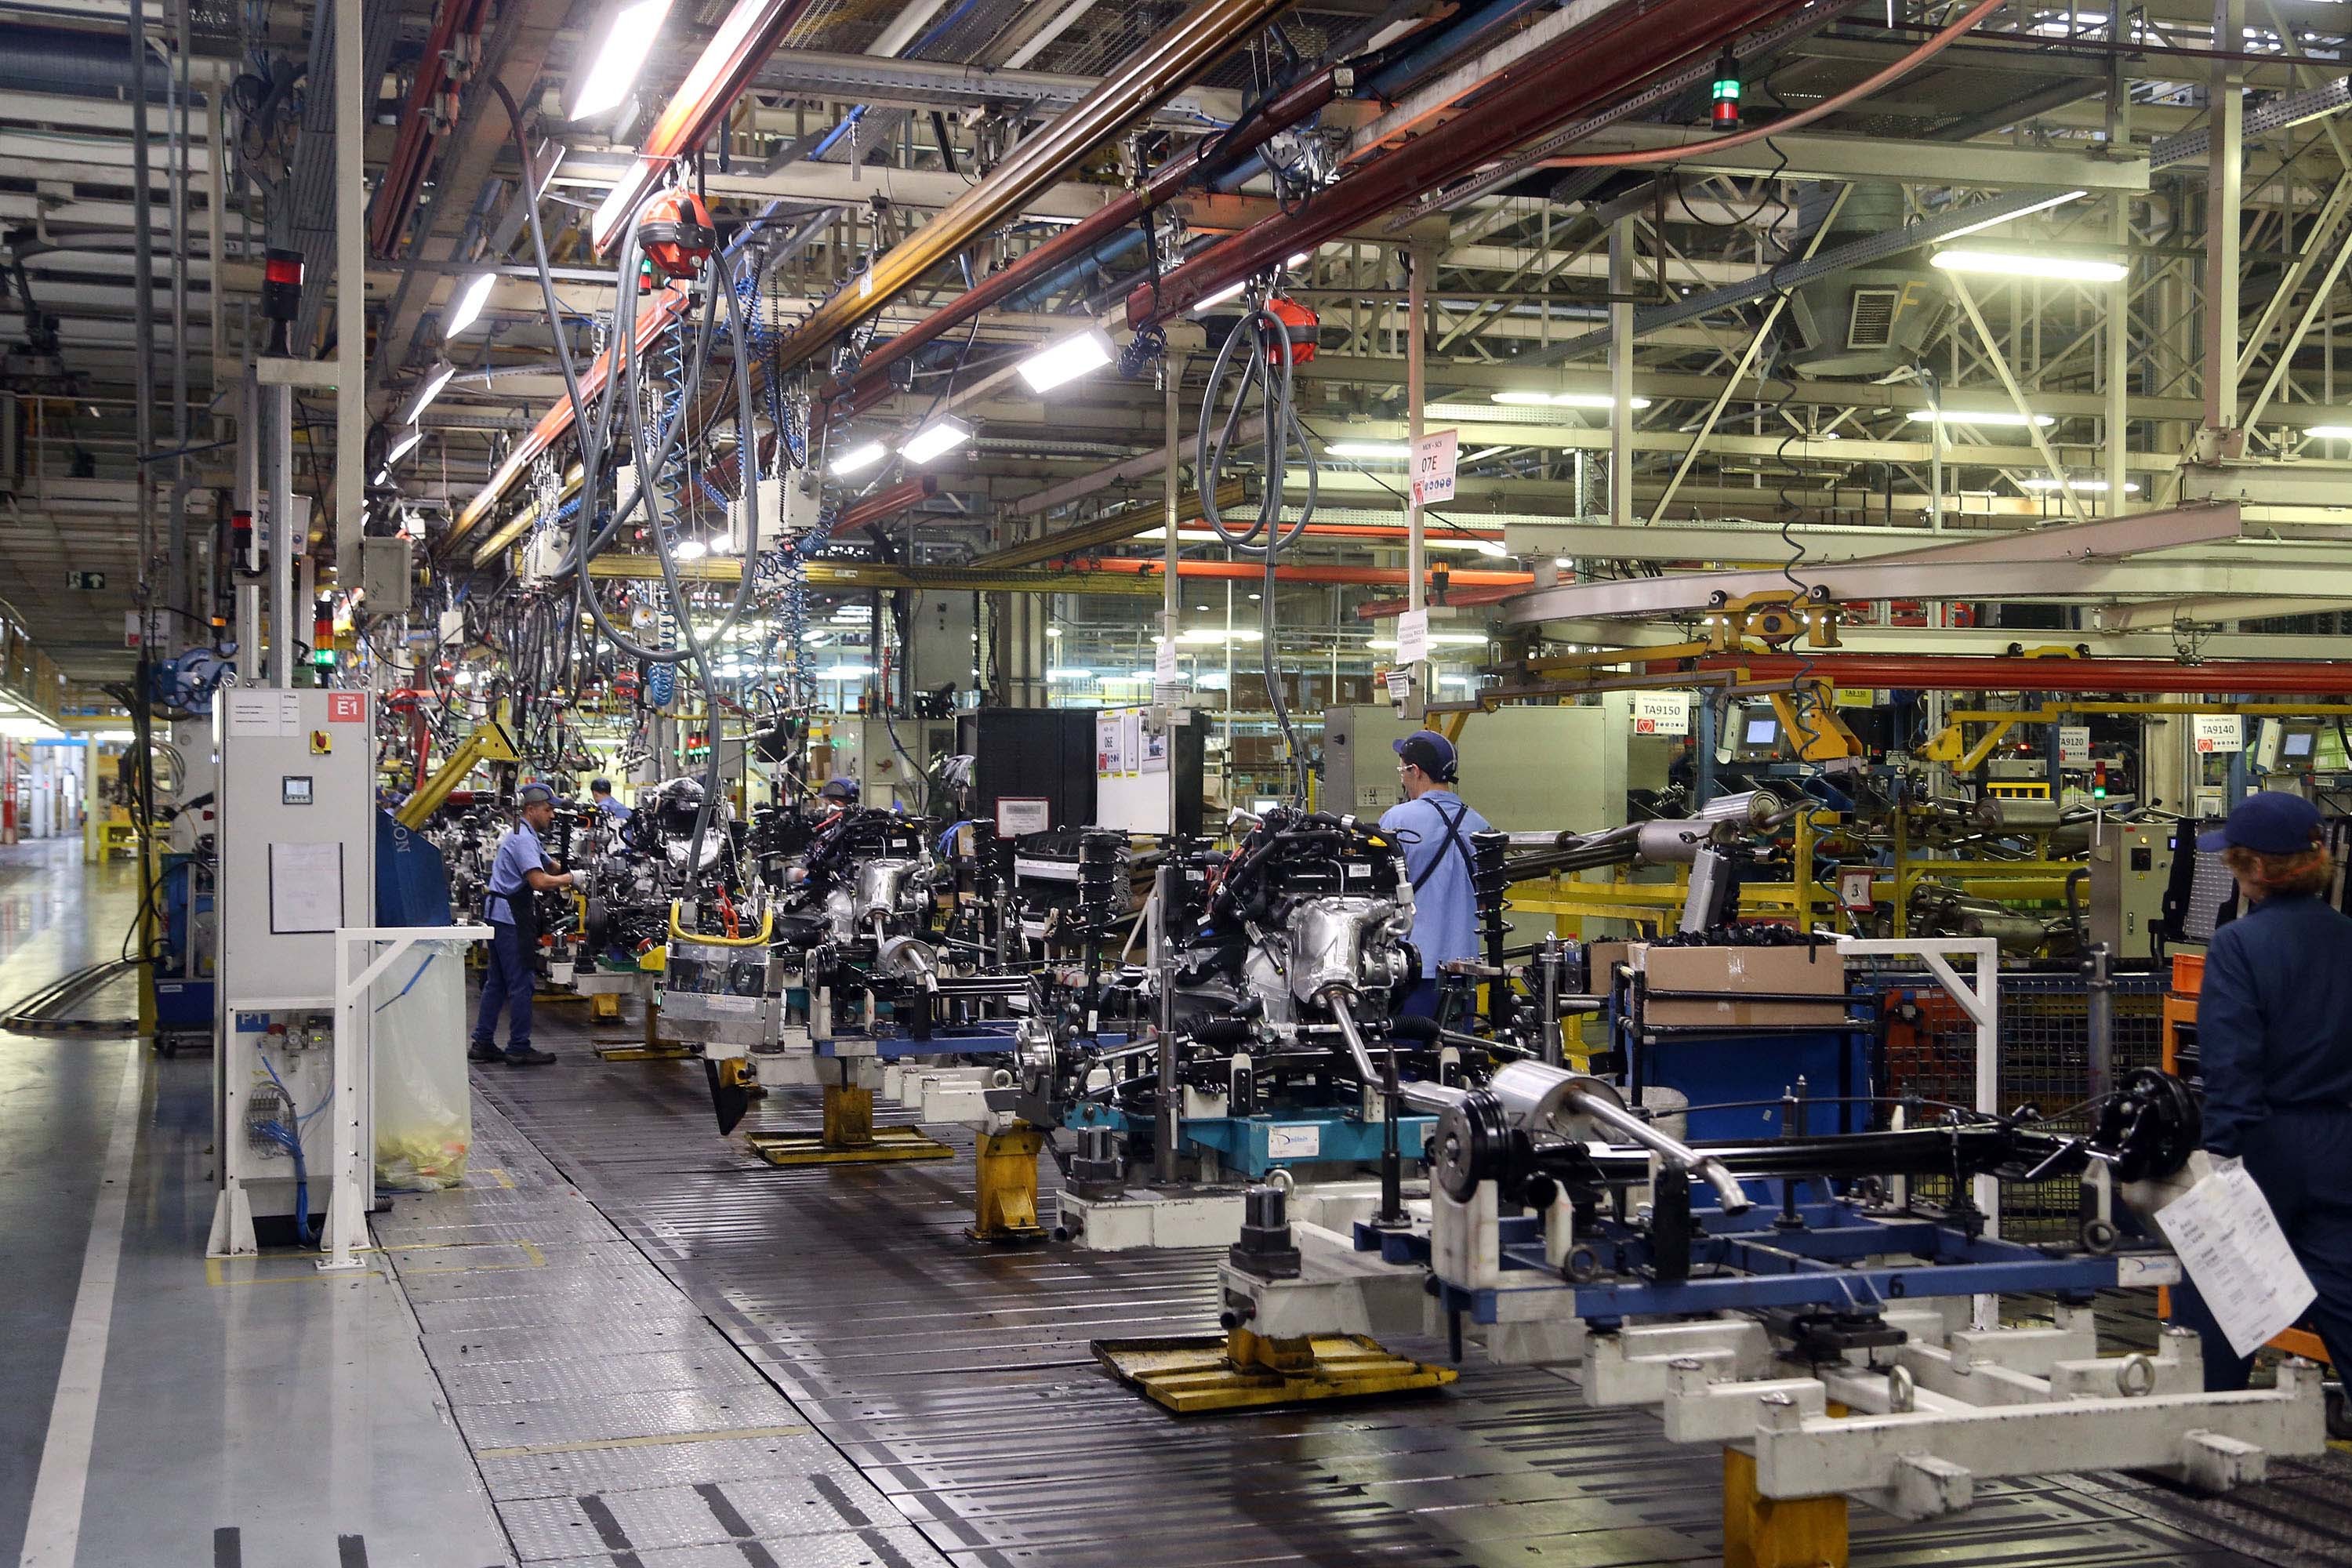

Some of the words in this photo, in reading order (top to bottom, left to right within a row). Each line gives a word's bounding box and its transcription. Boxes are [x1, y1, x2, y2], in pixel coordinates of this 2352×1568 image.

[1421, 455, 1438, 473] 07E
[337, 701, 358, 715] E1
[1644, 705, 1681, 716] TA9150
[2202, 725, 2234, 735] TA9140
[2060, 738, 2084, 746] A9120
[1851, 883, 1859, 898] 3
[1889, 1273, 1904, 1298] 6
